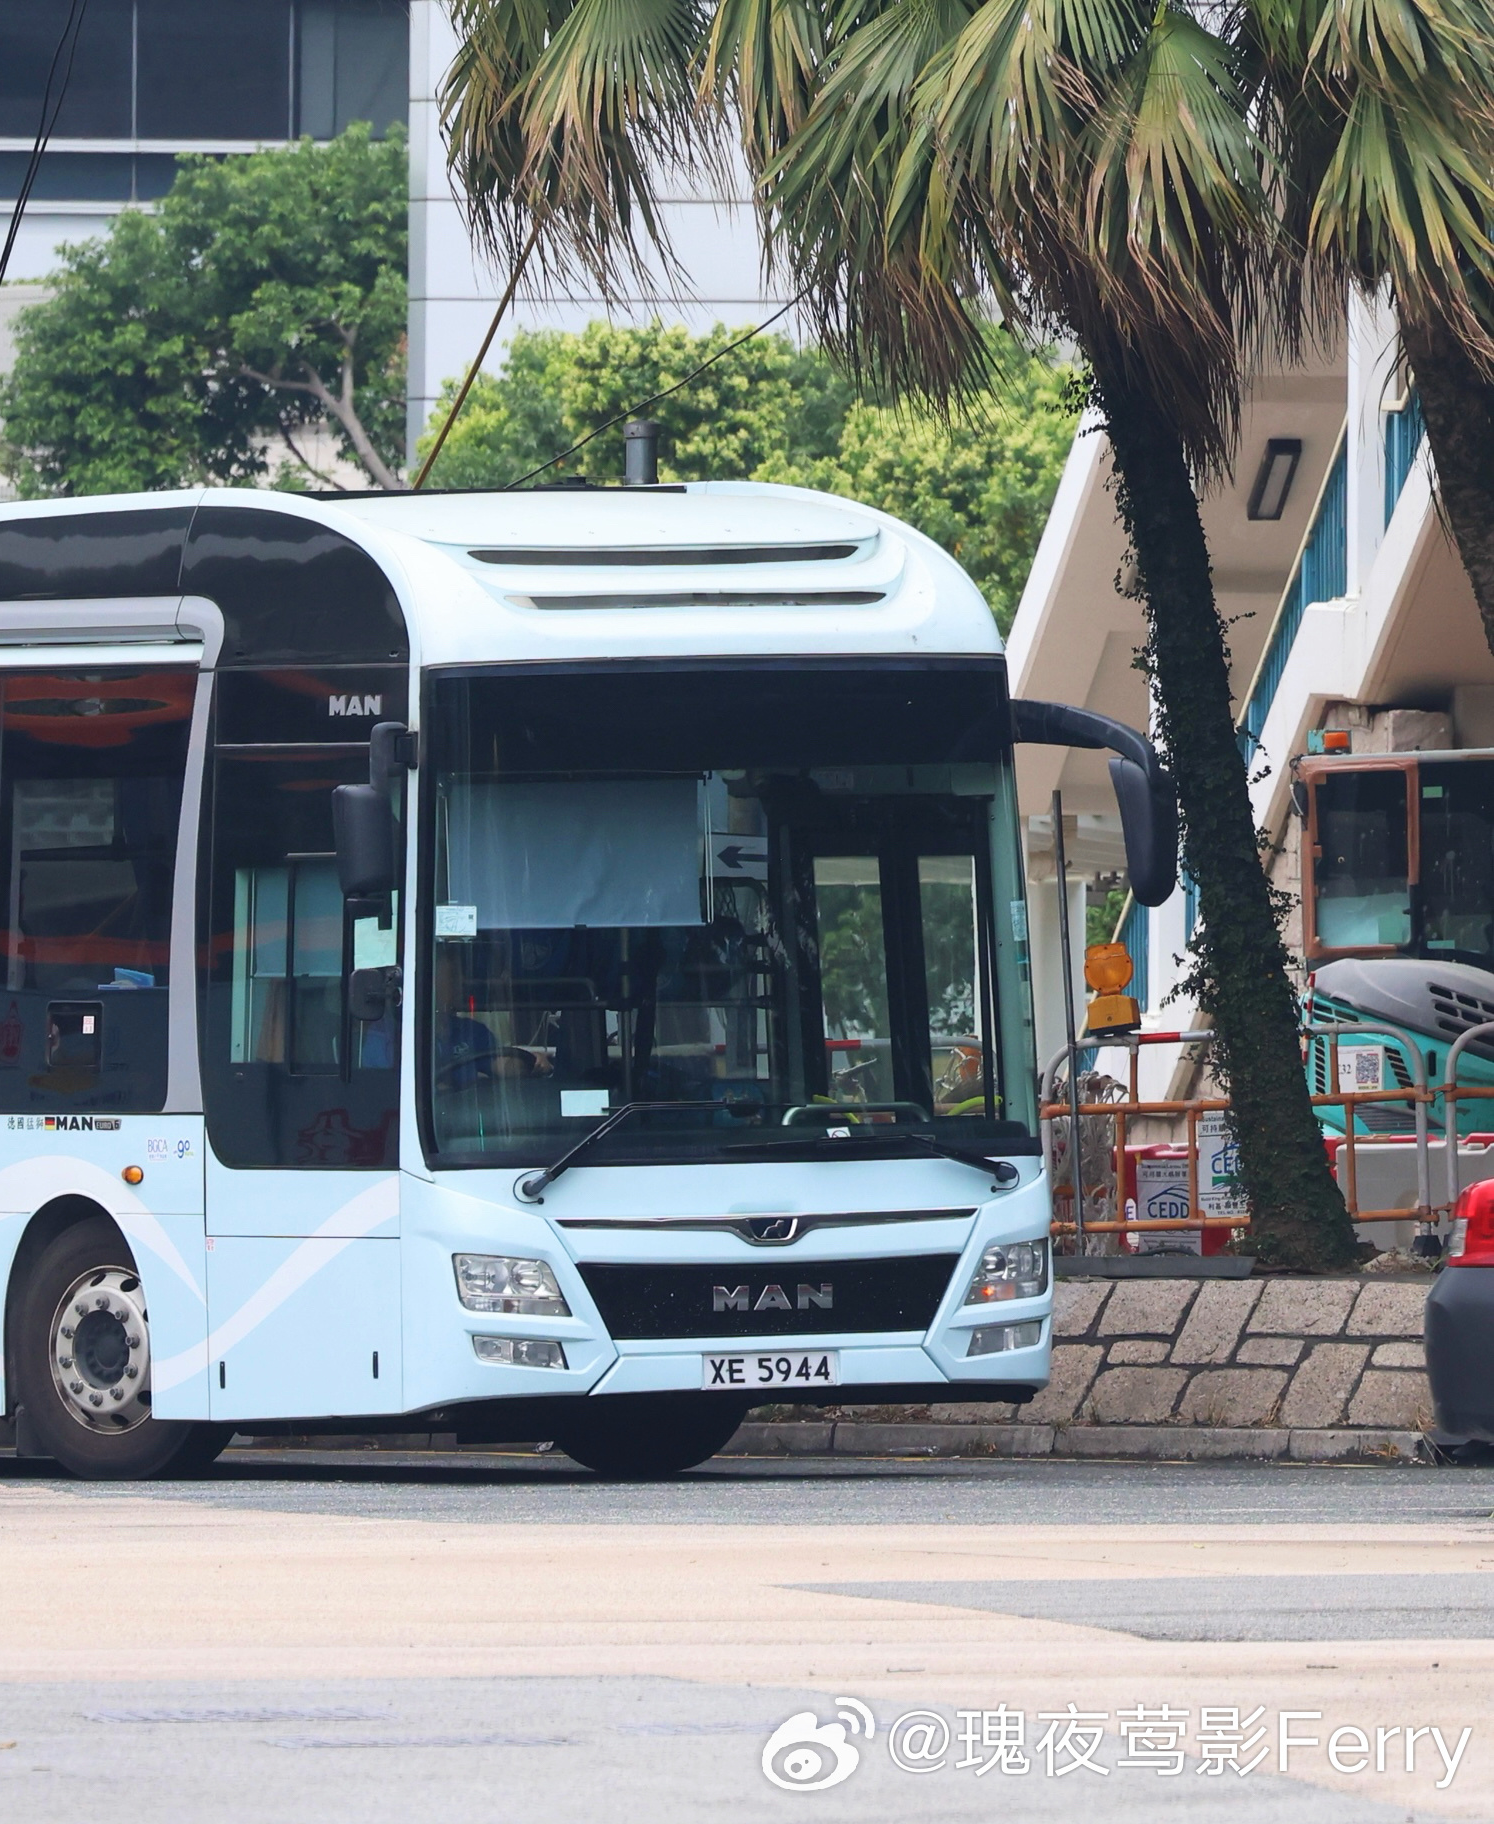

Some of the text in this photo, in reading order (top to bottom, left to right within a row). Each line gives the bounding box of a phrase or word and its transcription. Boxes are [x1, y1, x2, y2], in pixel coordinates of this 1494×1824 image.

[329, 694, 382, 717] MAN
[1338, 1064, 1352, 1075] 32
[56, 1116, 94, 1131] MAN
[96, 1120, 112, 1130] EURO
[147, 1138, 169, 1153] BGCA
[1147, 1201, 1190, 1219] CEDD
[712, 1283, 834, 1312] MAN
[709, 1355, 831, 1385] XE 5944
